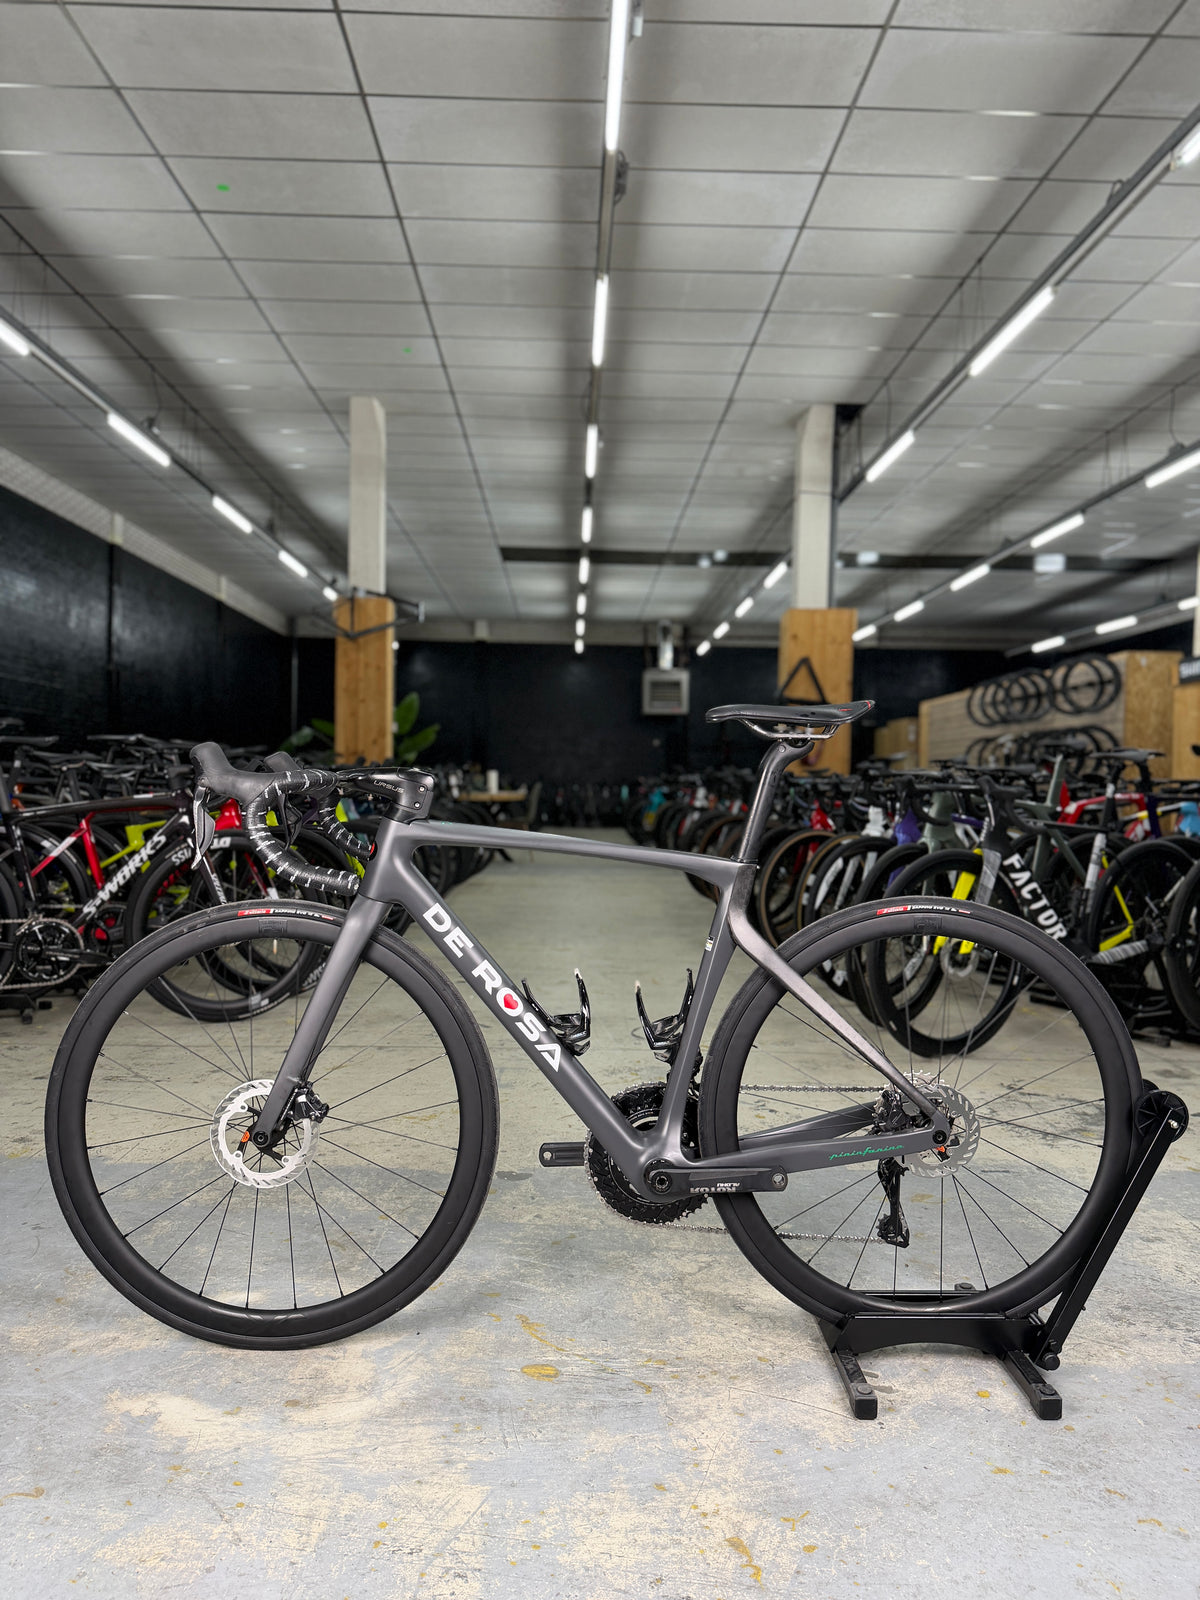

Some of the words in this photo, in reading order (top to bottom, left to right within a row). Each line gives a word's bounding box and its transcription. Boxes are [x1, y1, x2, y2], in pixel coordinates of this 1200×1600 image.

[373, 779, 405, 794] URSUS
[82, 834, 167, 921] S-WORKS
[1002, 852, 1067, 940] FACTOR
[422, 902, 474, 959] DE
[471, 959, 562, 1072] ROSA
[828, 1145, 905, 1161] pininfarina
